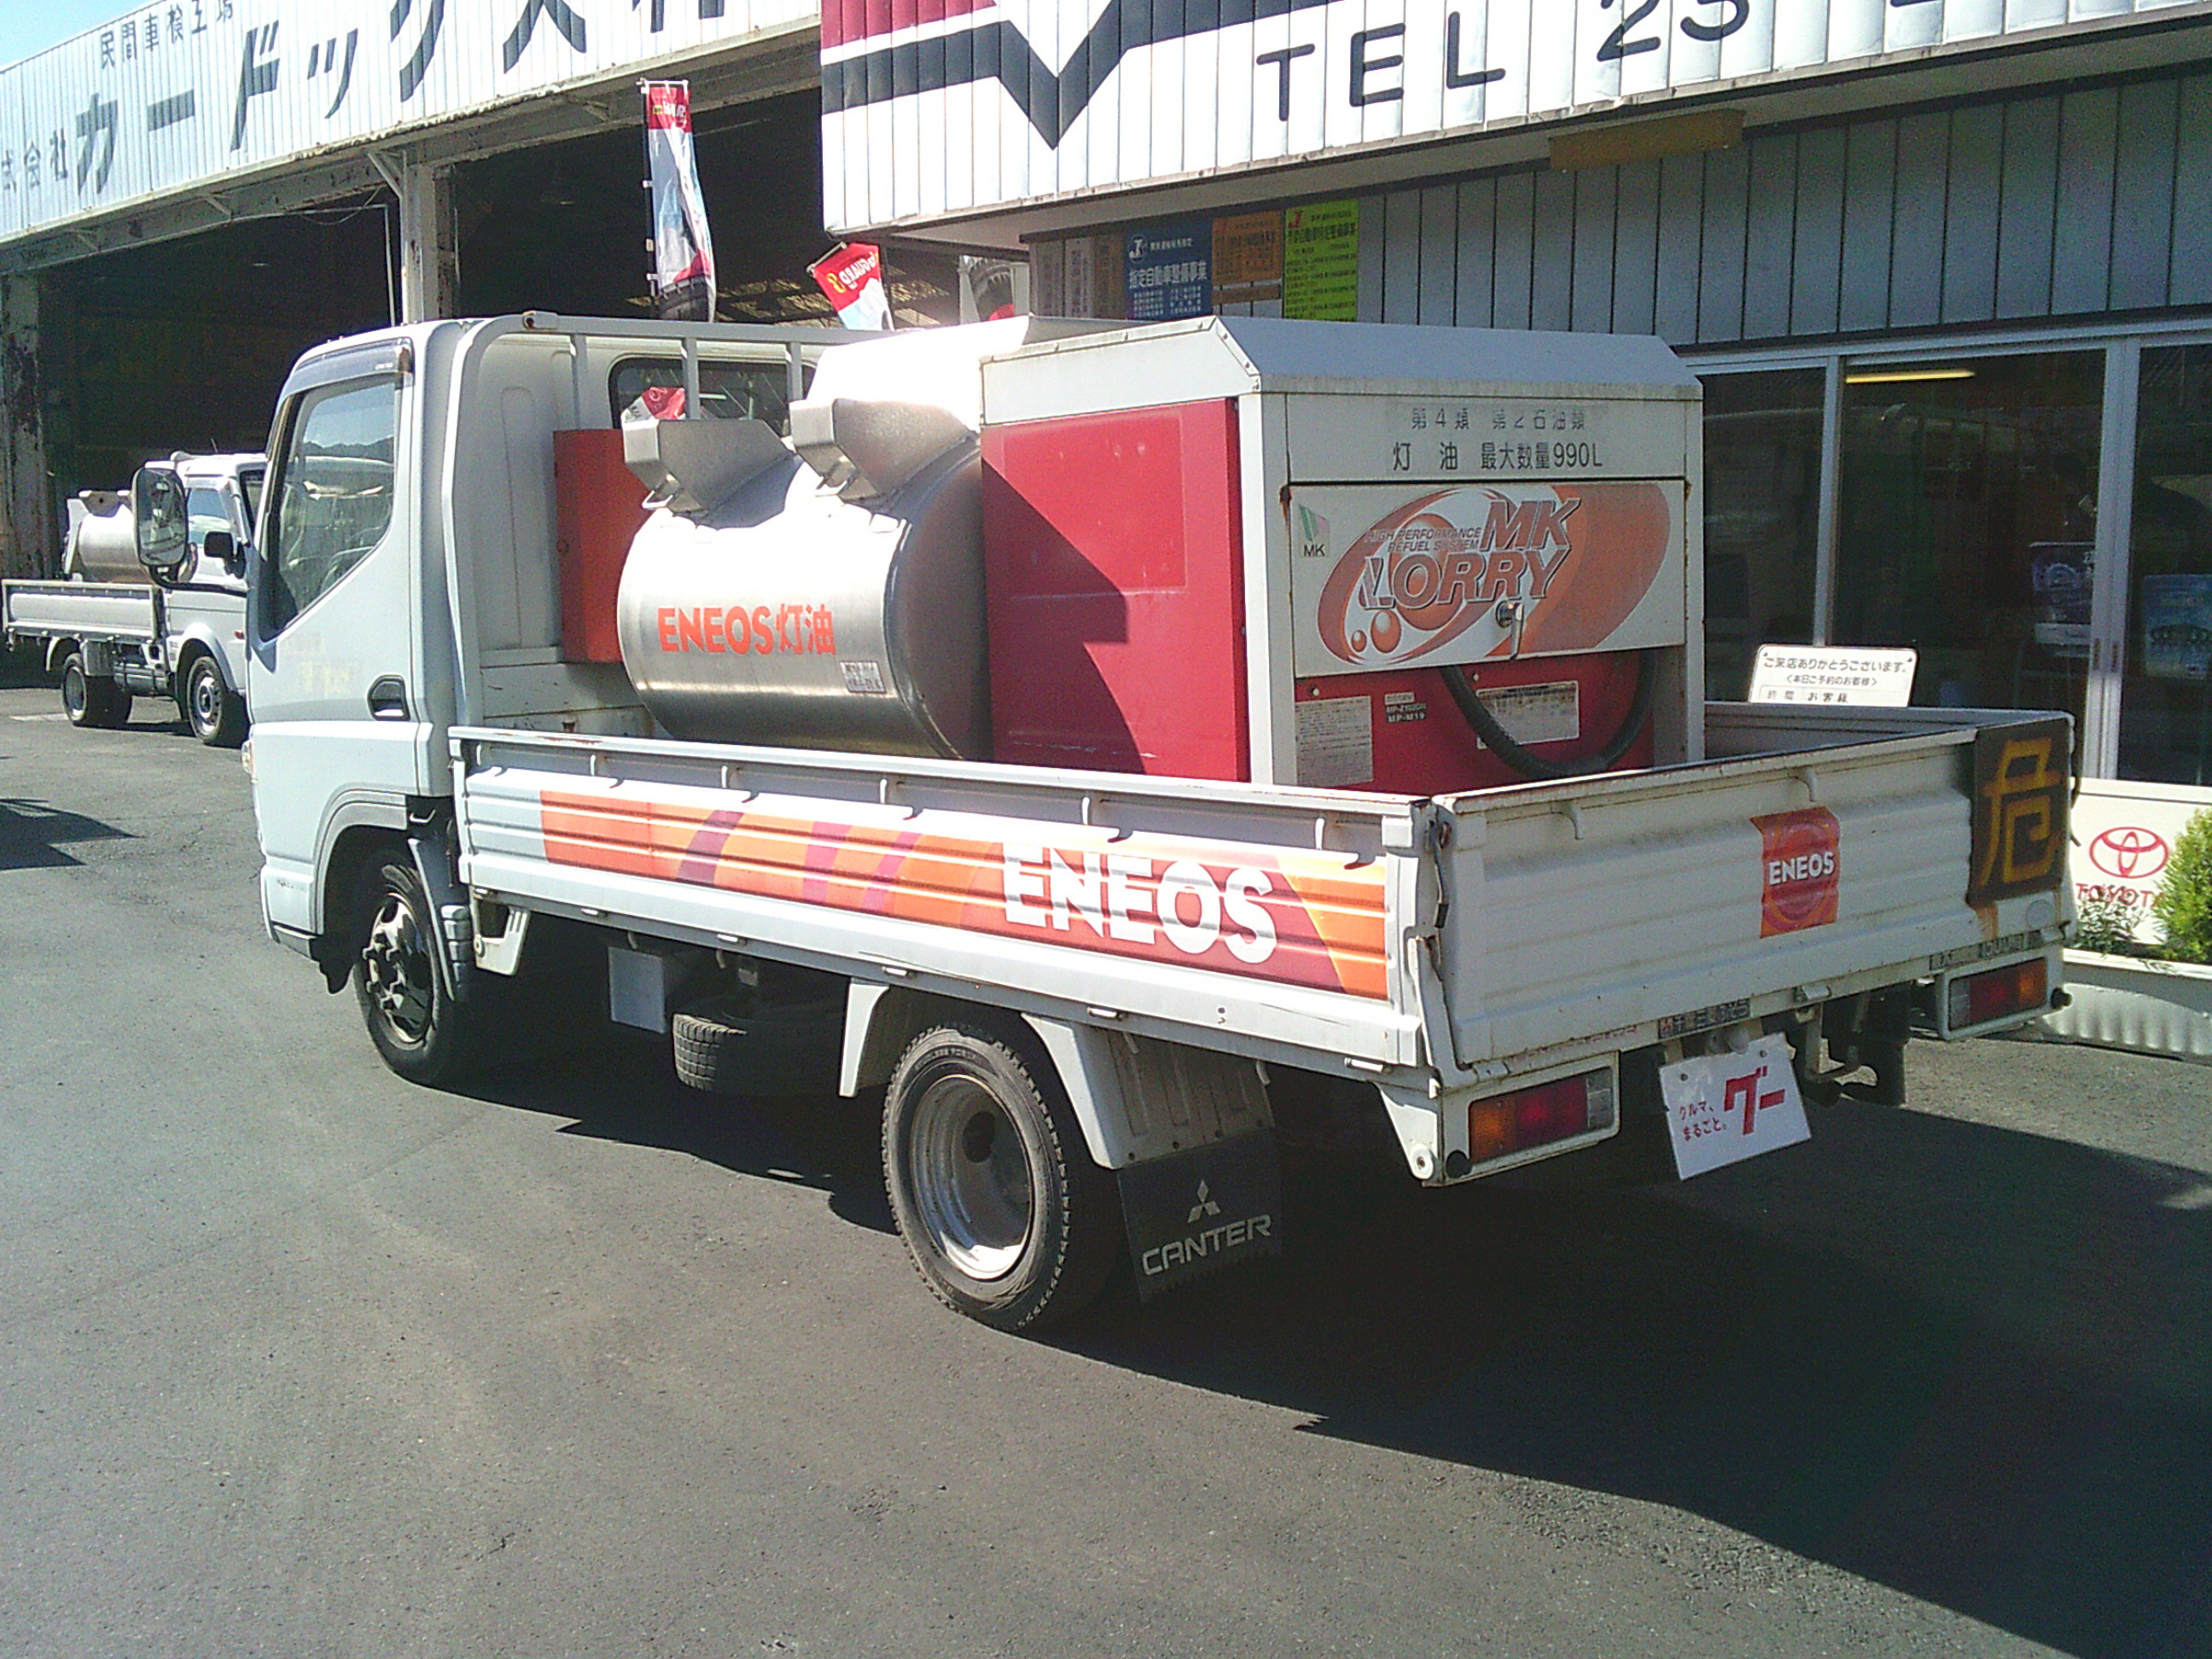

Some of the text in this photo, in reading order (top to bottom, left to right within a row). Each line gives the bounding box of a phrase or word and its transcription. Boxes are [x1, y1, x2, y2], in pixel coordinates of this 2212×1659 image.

[1256, 12, 1506, 121] TEL
[1303, 544, 1324, 557] MK
[1388, 540, 1430, 552] REFUEL
[1479, 498, 1580, 551] MK
[1360, 550, 1570, 610] LORRY
[1769, 852, 1835, 886] ENEOS
[1003, 842, 1278, 963] ENEOS
[1724, 1065, 1785, 1136] グー
[1142, 1214, 1272, 1276] CANTER
